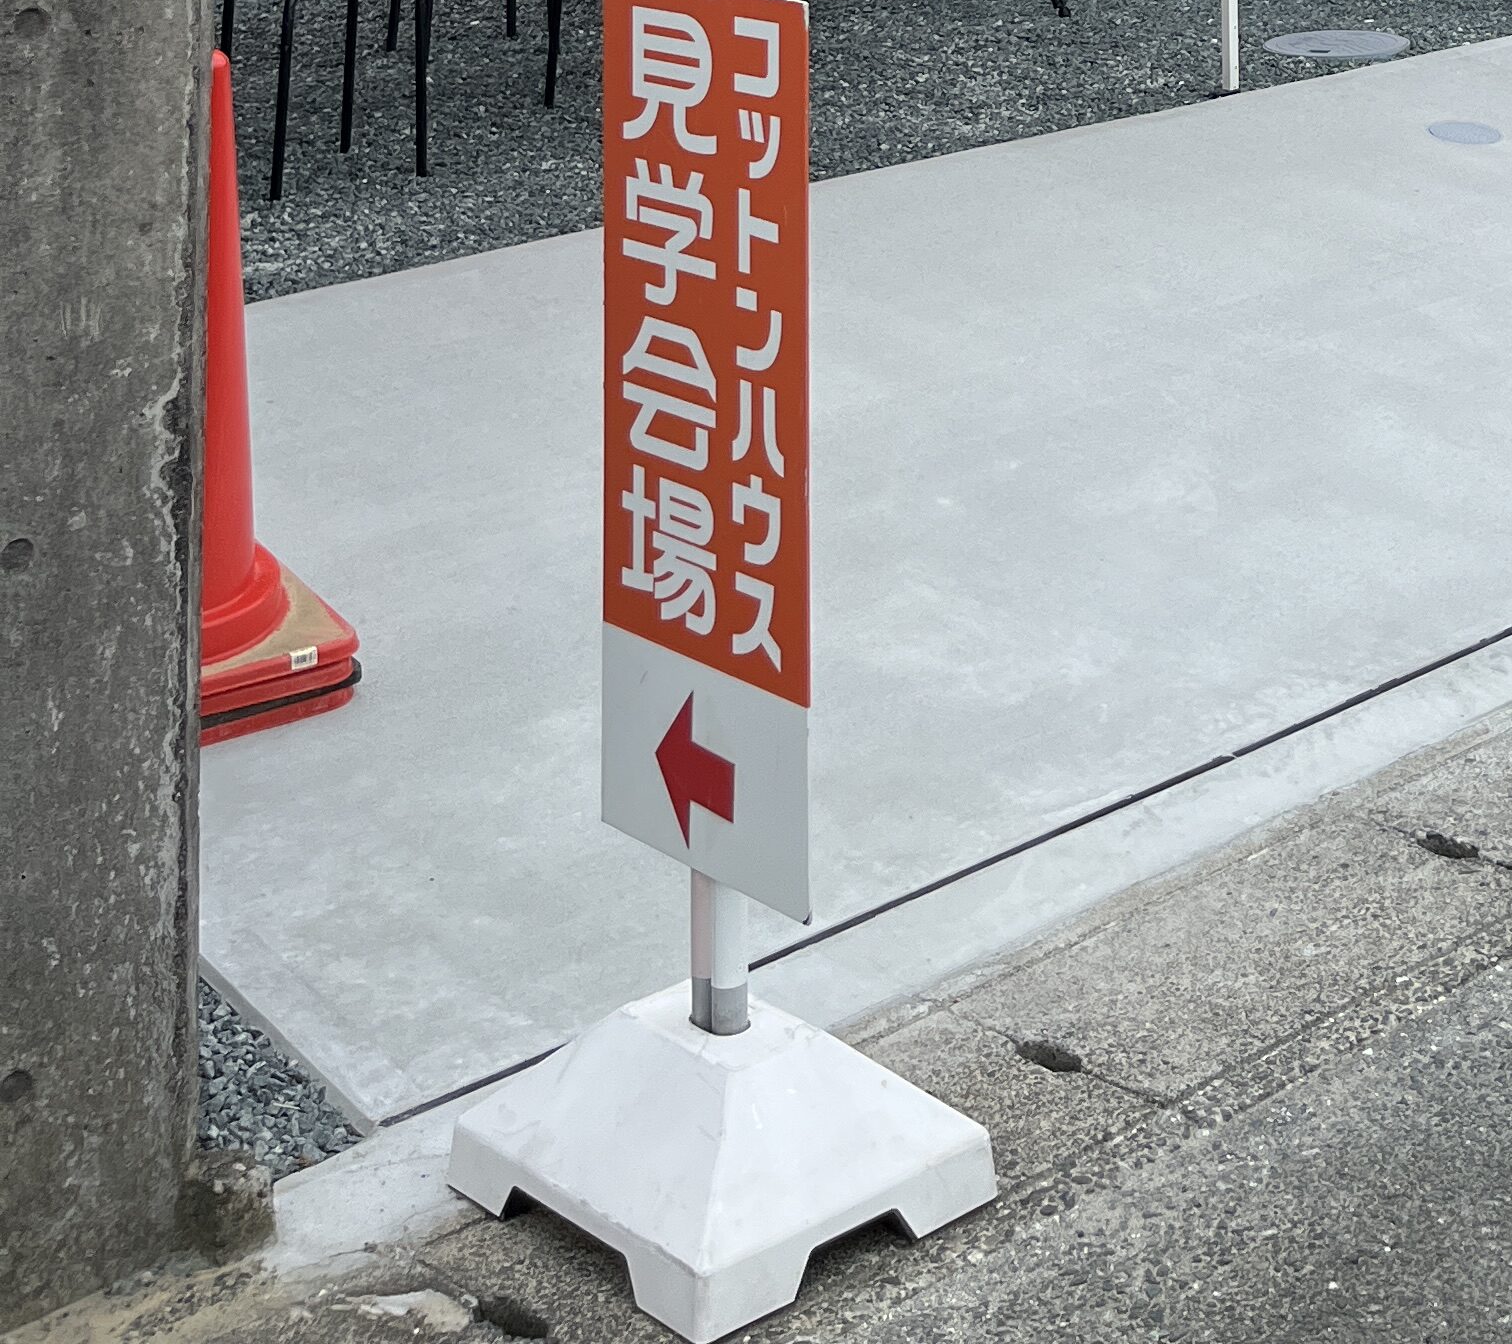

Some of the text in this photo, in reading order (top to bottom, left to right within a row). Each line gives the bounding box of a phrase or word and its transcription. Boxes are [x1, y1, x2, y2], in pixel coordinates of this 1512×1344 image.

[622, 5, 717, 636] 見学会場
[731, 16, 784, 672] コットンハウス
